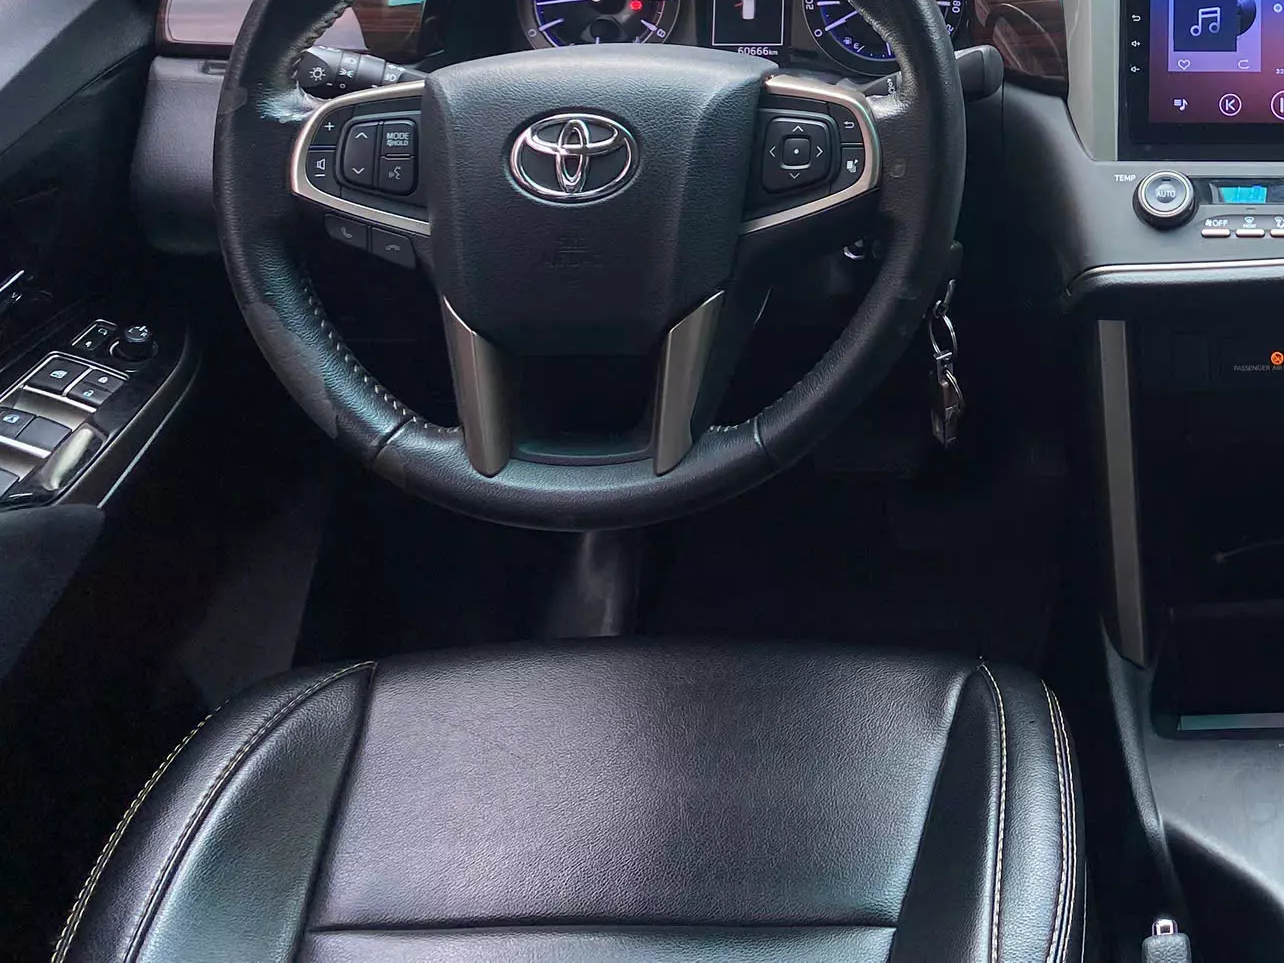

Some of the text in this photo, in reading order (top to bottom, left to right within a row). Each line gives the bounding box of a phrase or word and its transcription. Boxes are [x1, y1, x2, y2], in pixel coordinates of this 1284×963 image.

[528, 28, 537, 37] 0
[656, 28, 666, 38] 8
[814, 29, 823, 37] 0
[1155, 189, 1176, 198] AUTO
[1212, 219, 1228, 227] OFF
